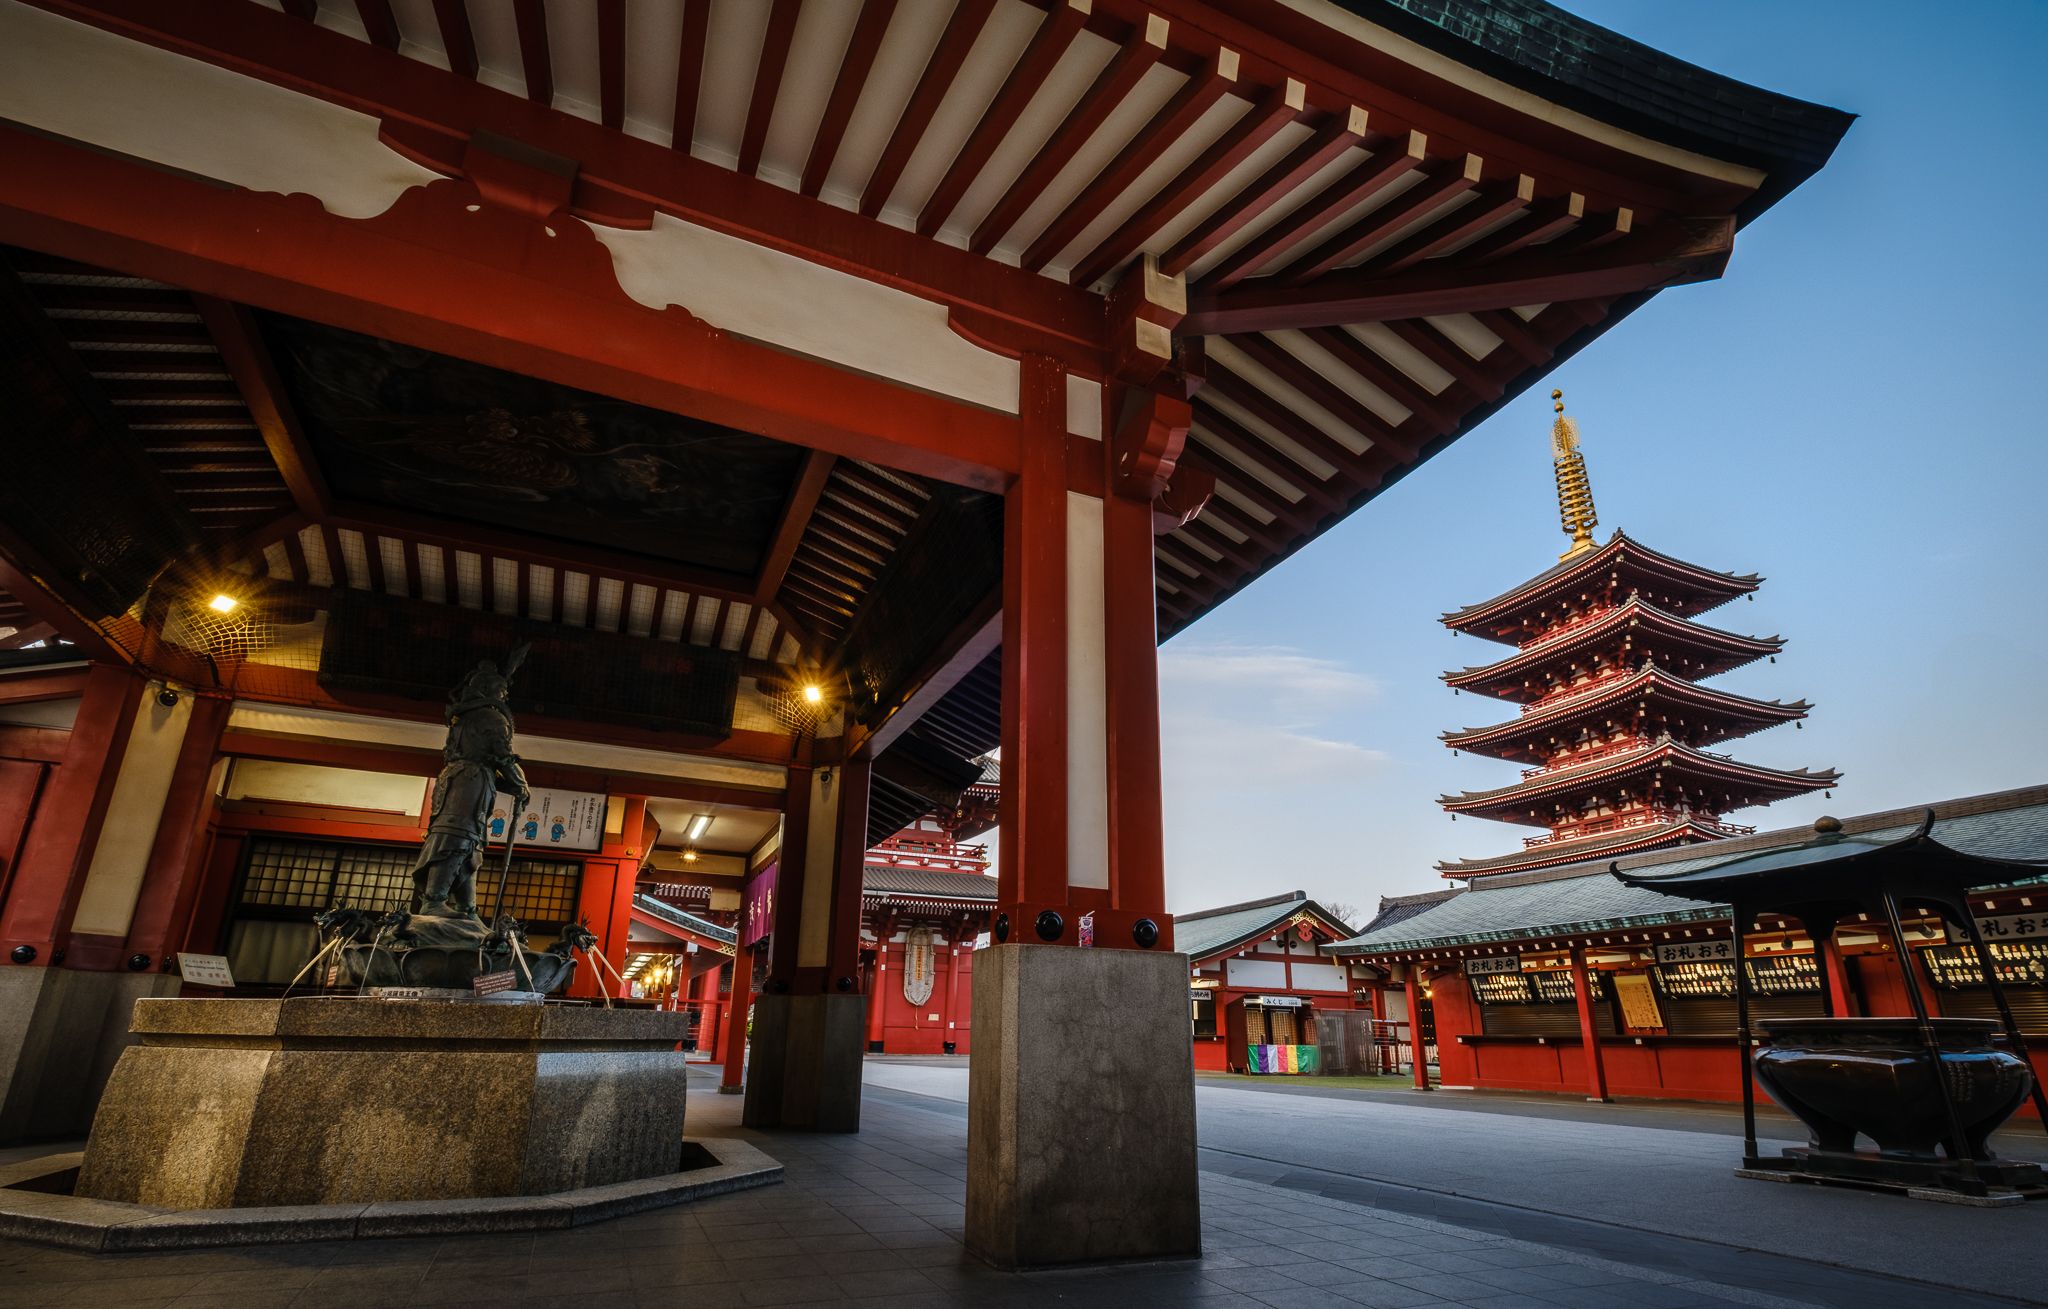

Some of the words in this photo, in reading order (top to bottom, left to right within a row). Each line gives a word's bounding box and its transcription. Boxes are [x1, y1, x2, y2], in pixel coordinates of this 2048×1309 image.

[1663, 942, 1730, 961] お札お守
[1471, 958, 1516, 972] お札お守
